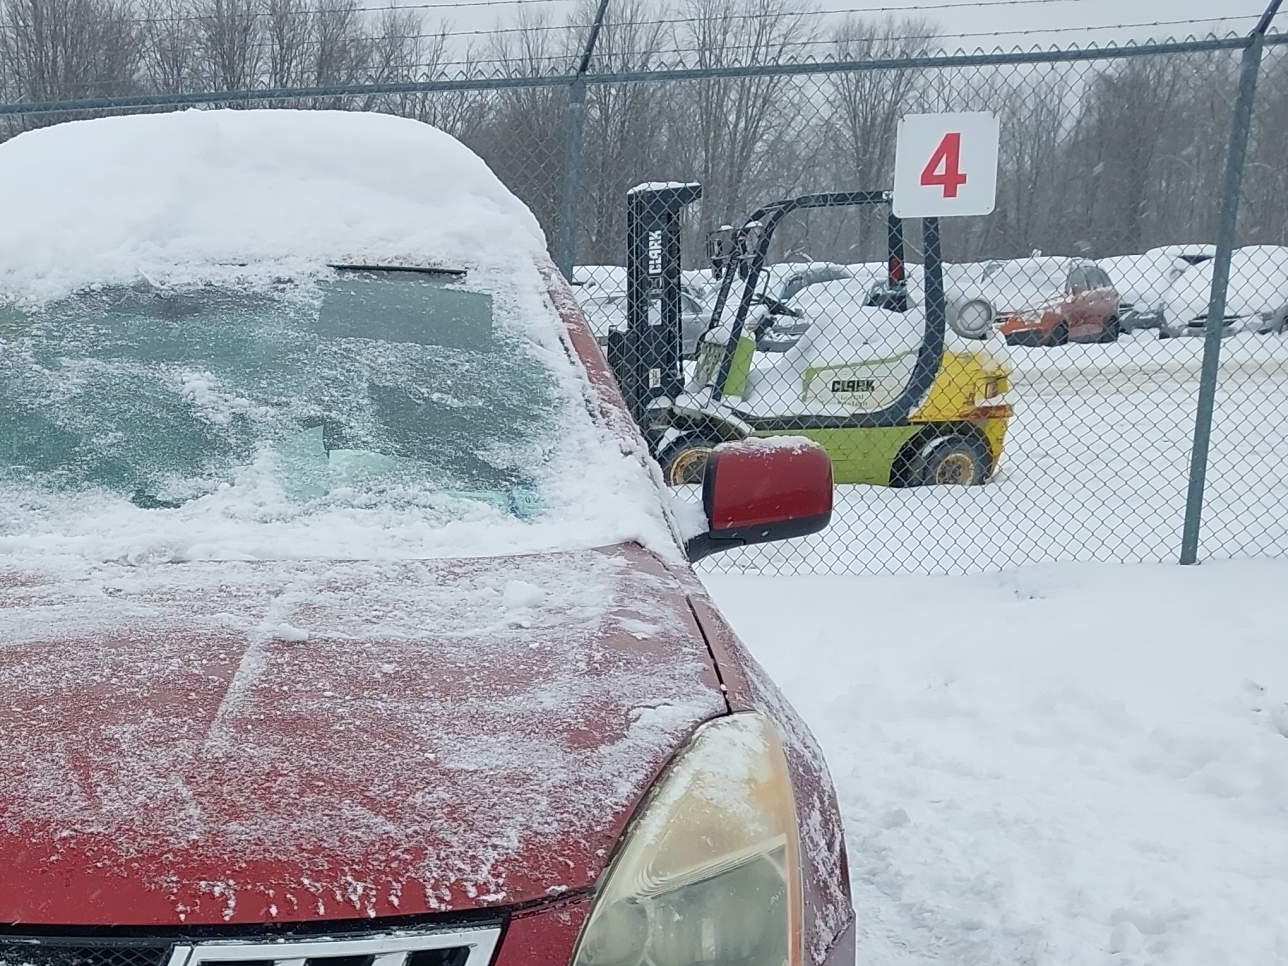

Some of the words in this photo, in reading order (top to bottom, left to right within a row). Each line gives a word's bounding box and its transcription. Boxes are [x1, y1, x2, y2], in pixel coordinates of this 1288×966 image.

[920, 132, 967, 198] 4
[648, 230, 662, 275] CLARK
[832, 380, 875, 392] CLARK
